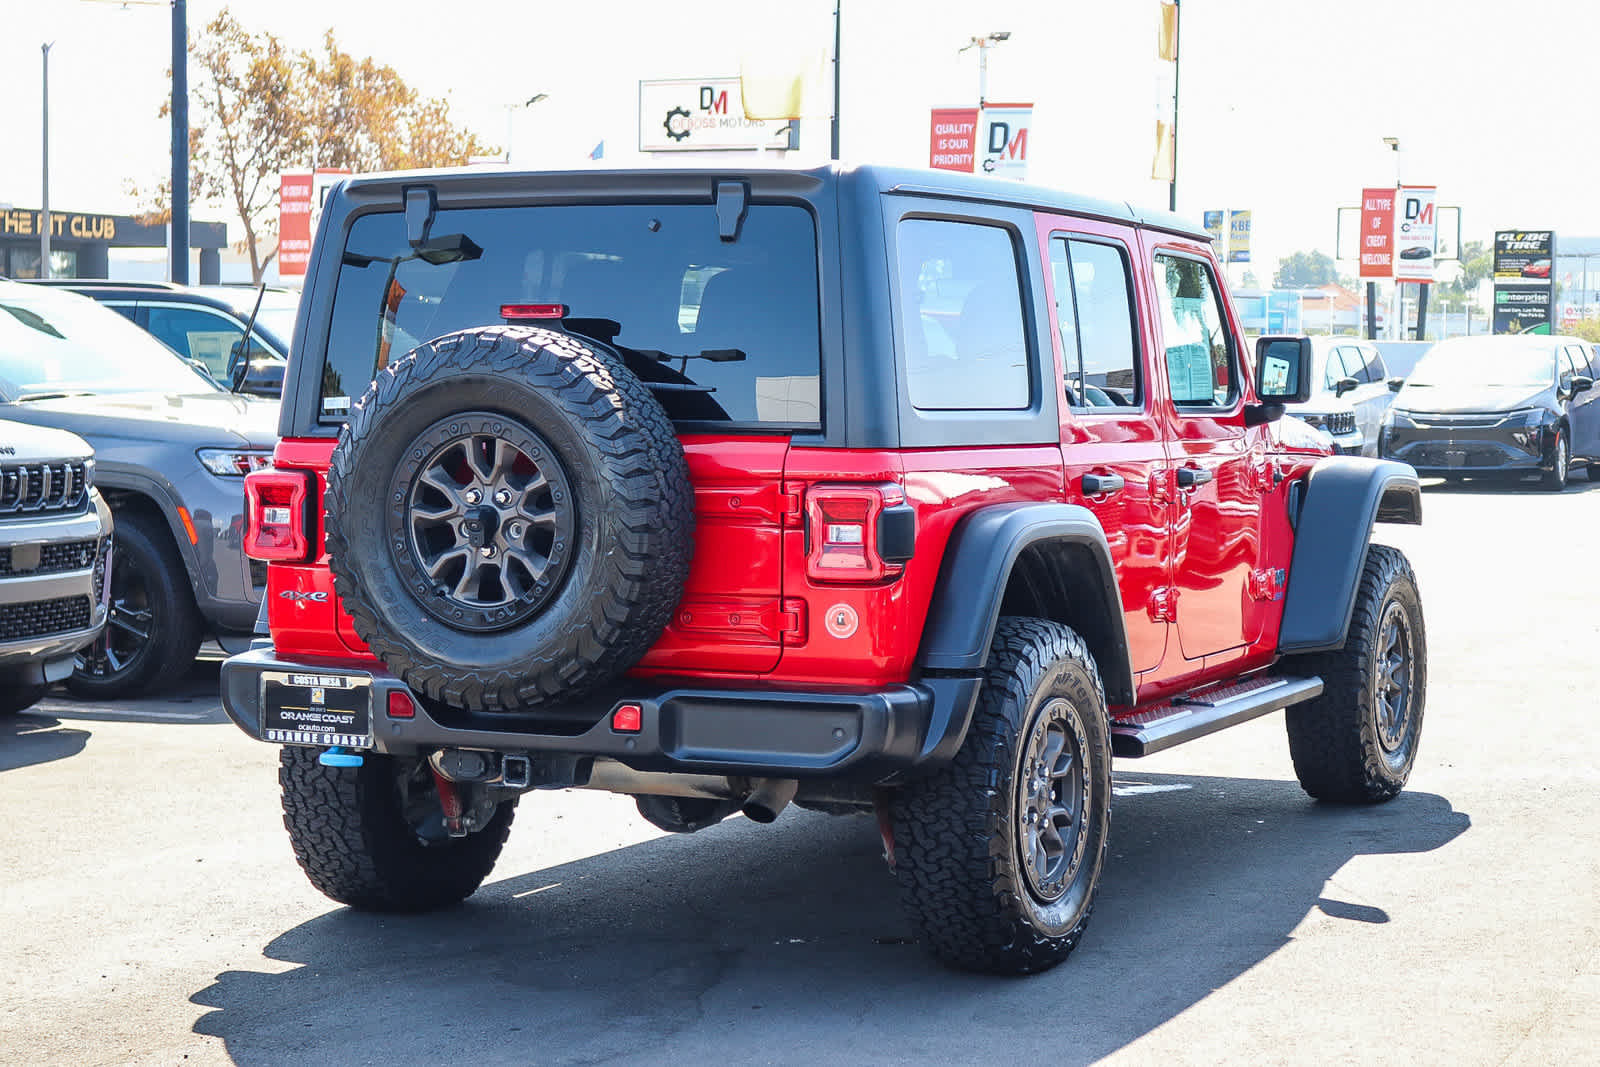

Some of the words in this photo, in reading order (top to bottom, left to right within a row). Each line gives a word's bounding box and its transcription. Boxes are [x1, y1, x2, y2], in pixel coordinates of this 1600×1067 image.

[935, 123, 974, 134] QUALITY
[939, 139, 948, 150] IS
[949, 139, 968, 150] OUR
[989, 122, 1028, 160] DM
[934, 154, 974, 166] PRIORITY
[1365, 199, 1377, 211] ALL
[1376, 199, 1392, 211] TYPE
[70, 215, 115, 240] CLUB
[1372, 216, 1382, 229] OF
[1366, 235, 1387, 248] CREDIT
[1361, 253, 1391, 265] WELCOME
[293, 675, 318, 686] COSTA
[322, 713, 355, 725] COAST
[298, 723, 336, 733] ocauto.com
[268, 731, 318, 743] ORANGE
[323, 735, 366, 746] COAST
